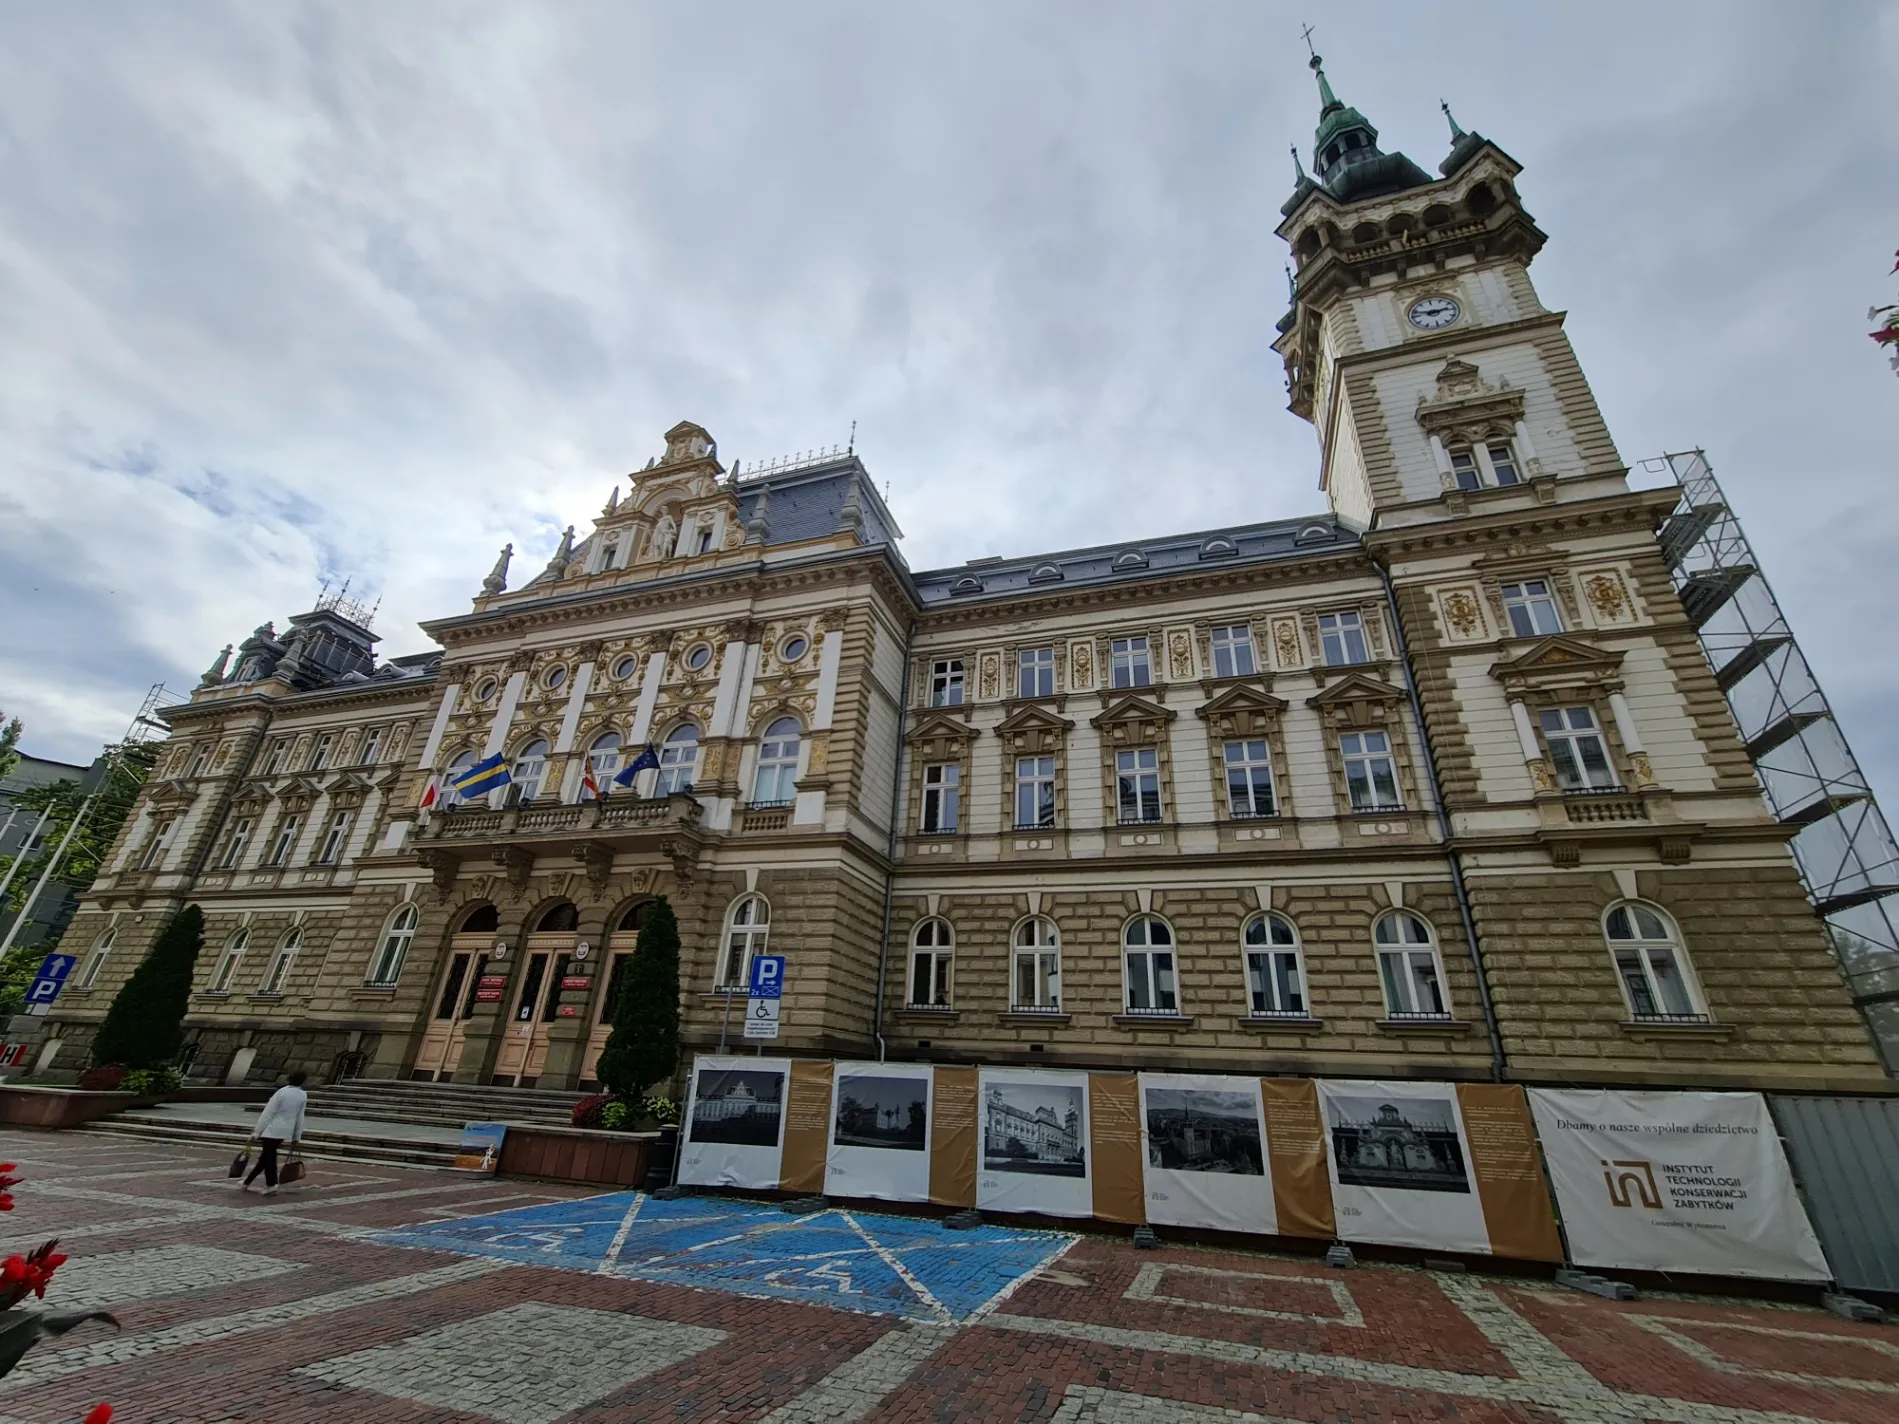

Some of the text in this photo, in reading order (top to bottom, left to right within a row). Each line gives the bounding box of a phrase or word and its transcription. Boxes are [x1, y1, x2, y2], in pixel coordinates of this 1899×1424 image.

[758, 959, 778, 986] P
[32, 980, 57, 1000] P
[1556, 1119, 1759, 1136] Dbamy o nasze wspólne dziedzictwo
[1662, 1164, 1714, 1175] INSTYTUT
[1665, 1175, 1742, 1188] TECHNOLOGII
[1669, 1187, 1748, 1199] KONSERWACJI
[1673, 1198, 1735, 1211] ZABYTKÓW
